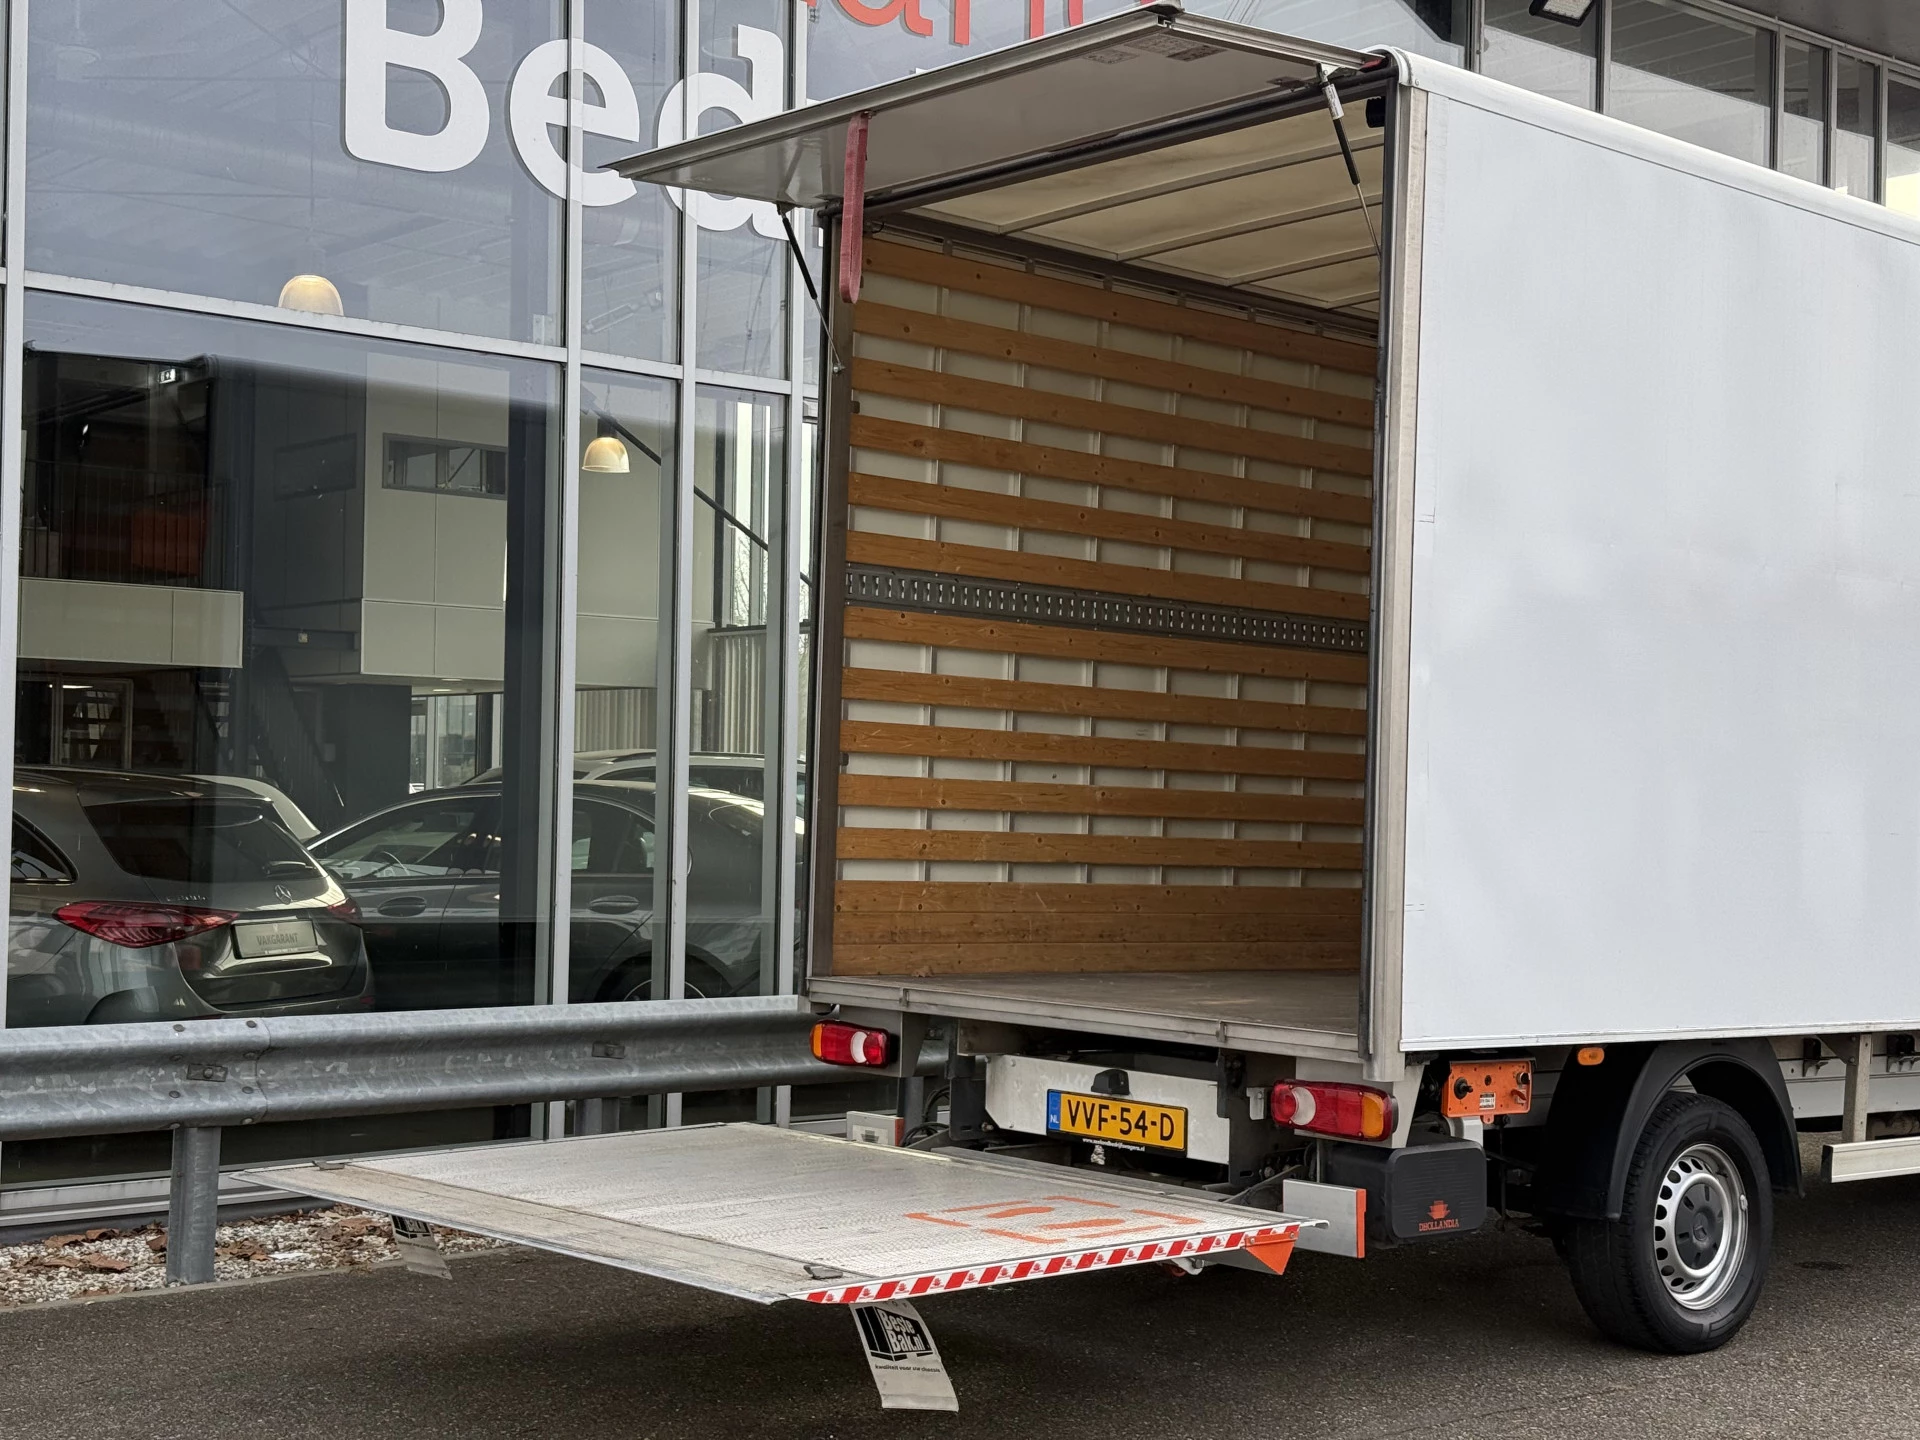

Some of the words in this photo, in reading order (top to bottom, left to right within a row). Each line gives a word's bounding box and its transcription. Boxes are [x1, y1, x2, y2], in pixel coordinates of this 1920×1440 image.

[1049, 1114, 1060, 1124] NL
[1067, 1099, 1175, 1141] VVF-54-D
[1418, 1218, 1460, 1232] DHOLLANDIA
[877, 1308, 915, 1334] Beste
[889, 1331, 926, 1353] Bak.nl
